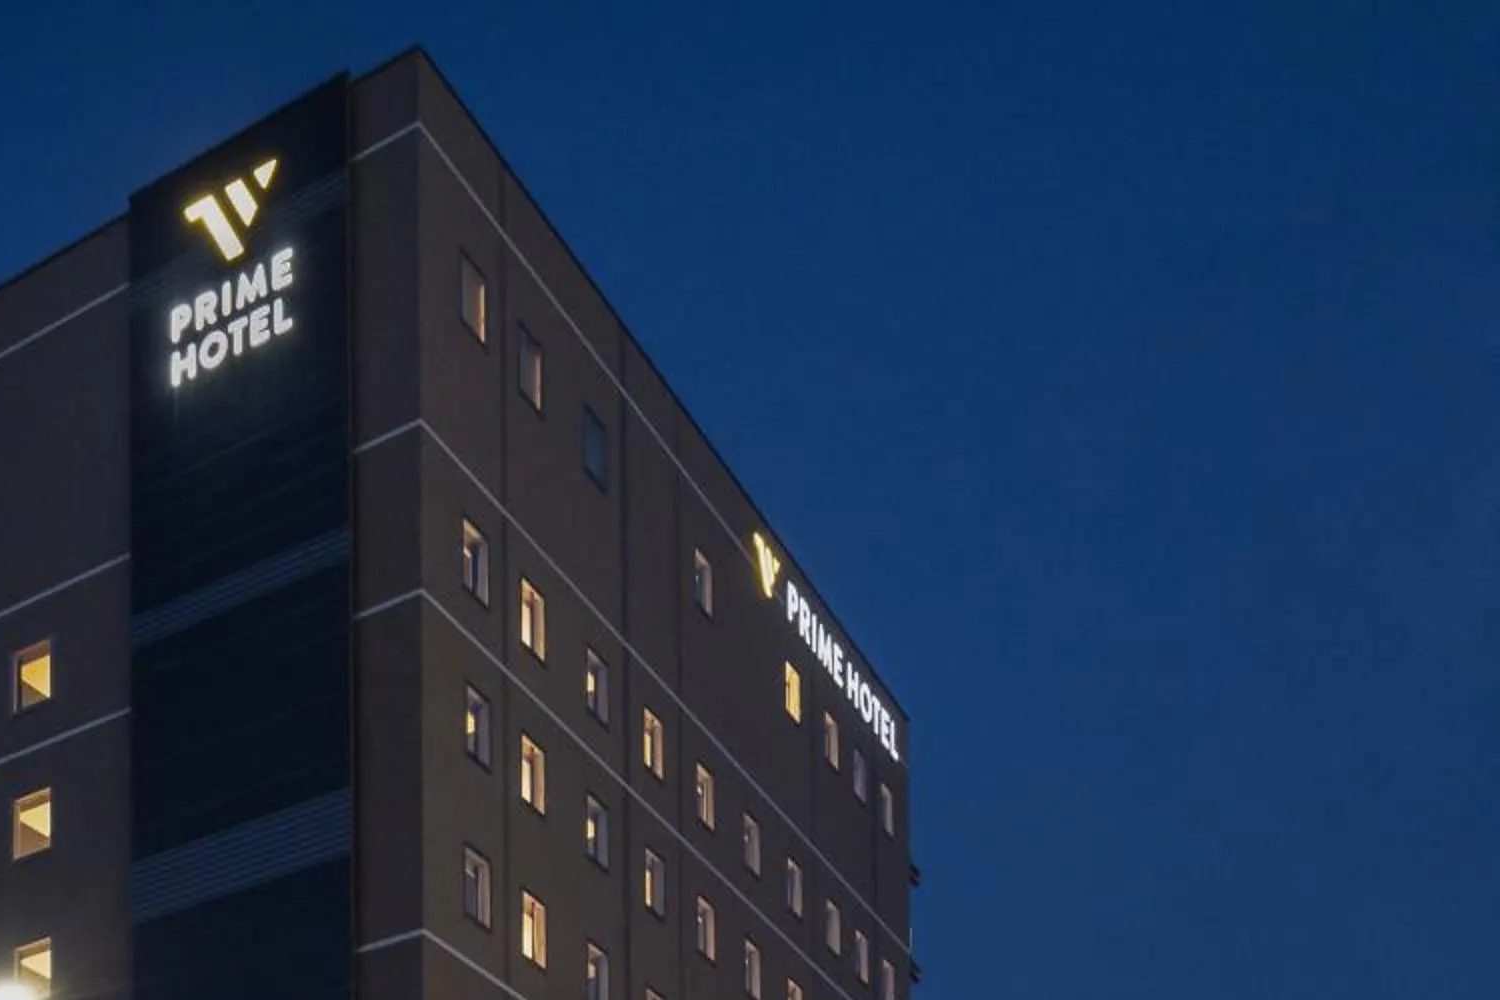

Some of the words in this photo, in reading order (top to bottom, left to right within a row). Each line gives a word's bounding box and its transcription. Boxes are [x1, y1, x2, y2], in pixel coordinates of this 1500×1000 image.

[170, 246, 294, 344] PRIME
[170, 297, 294, 388] HOTEL
[786, 579, 845, 688] PRIME
[847, 660, 900, 762] HOTEL
